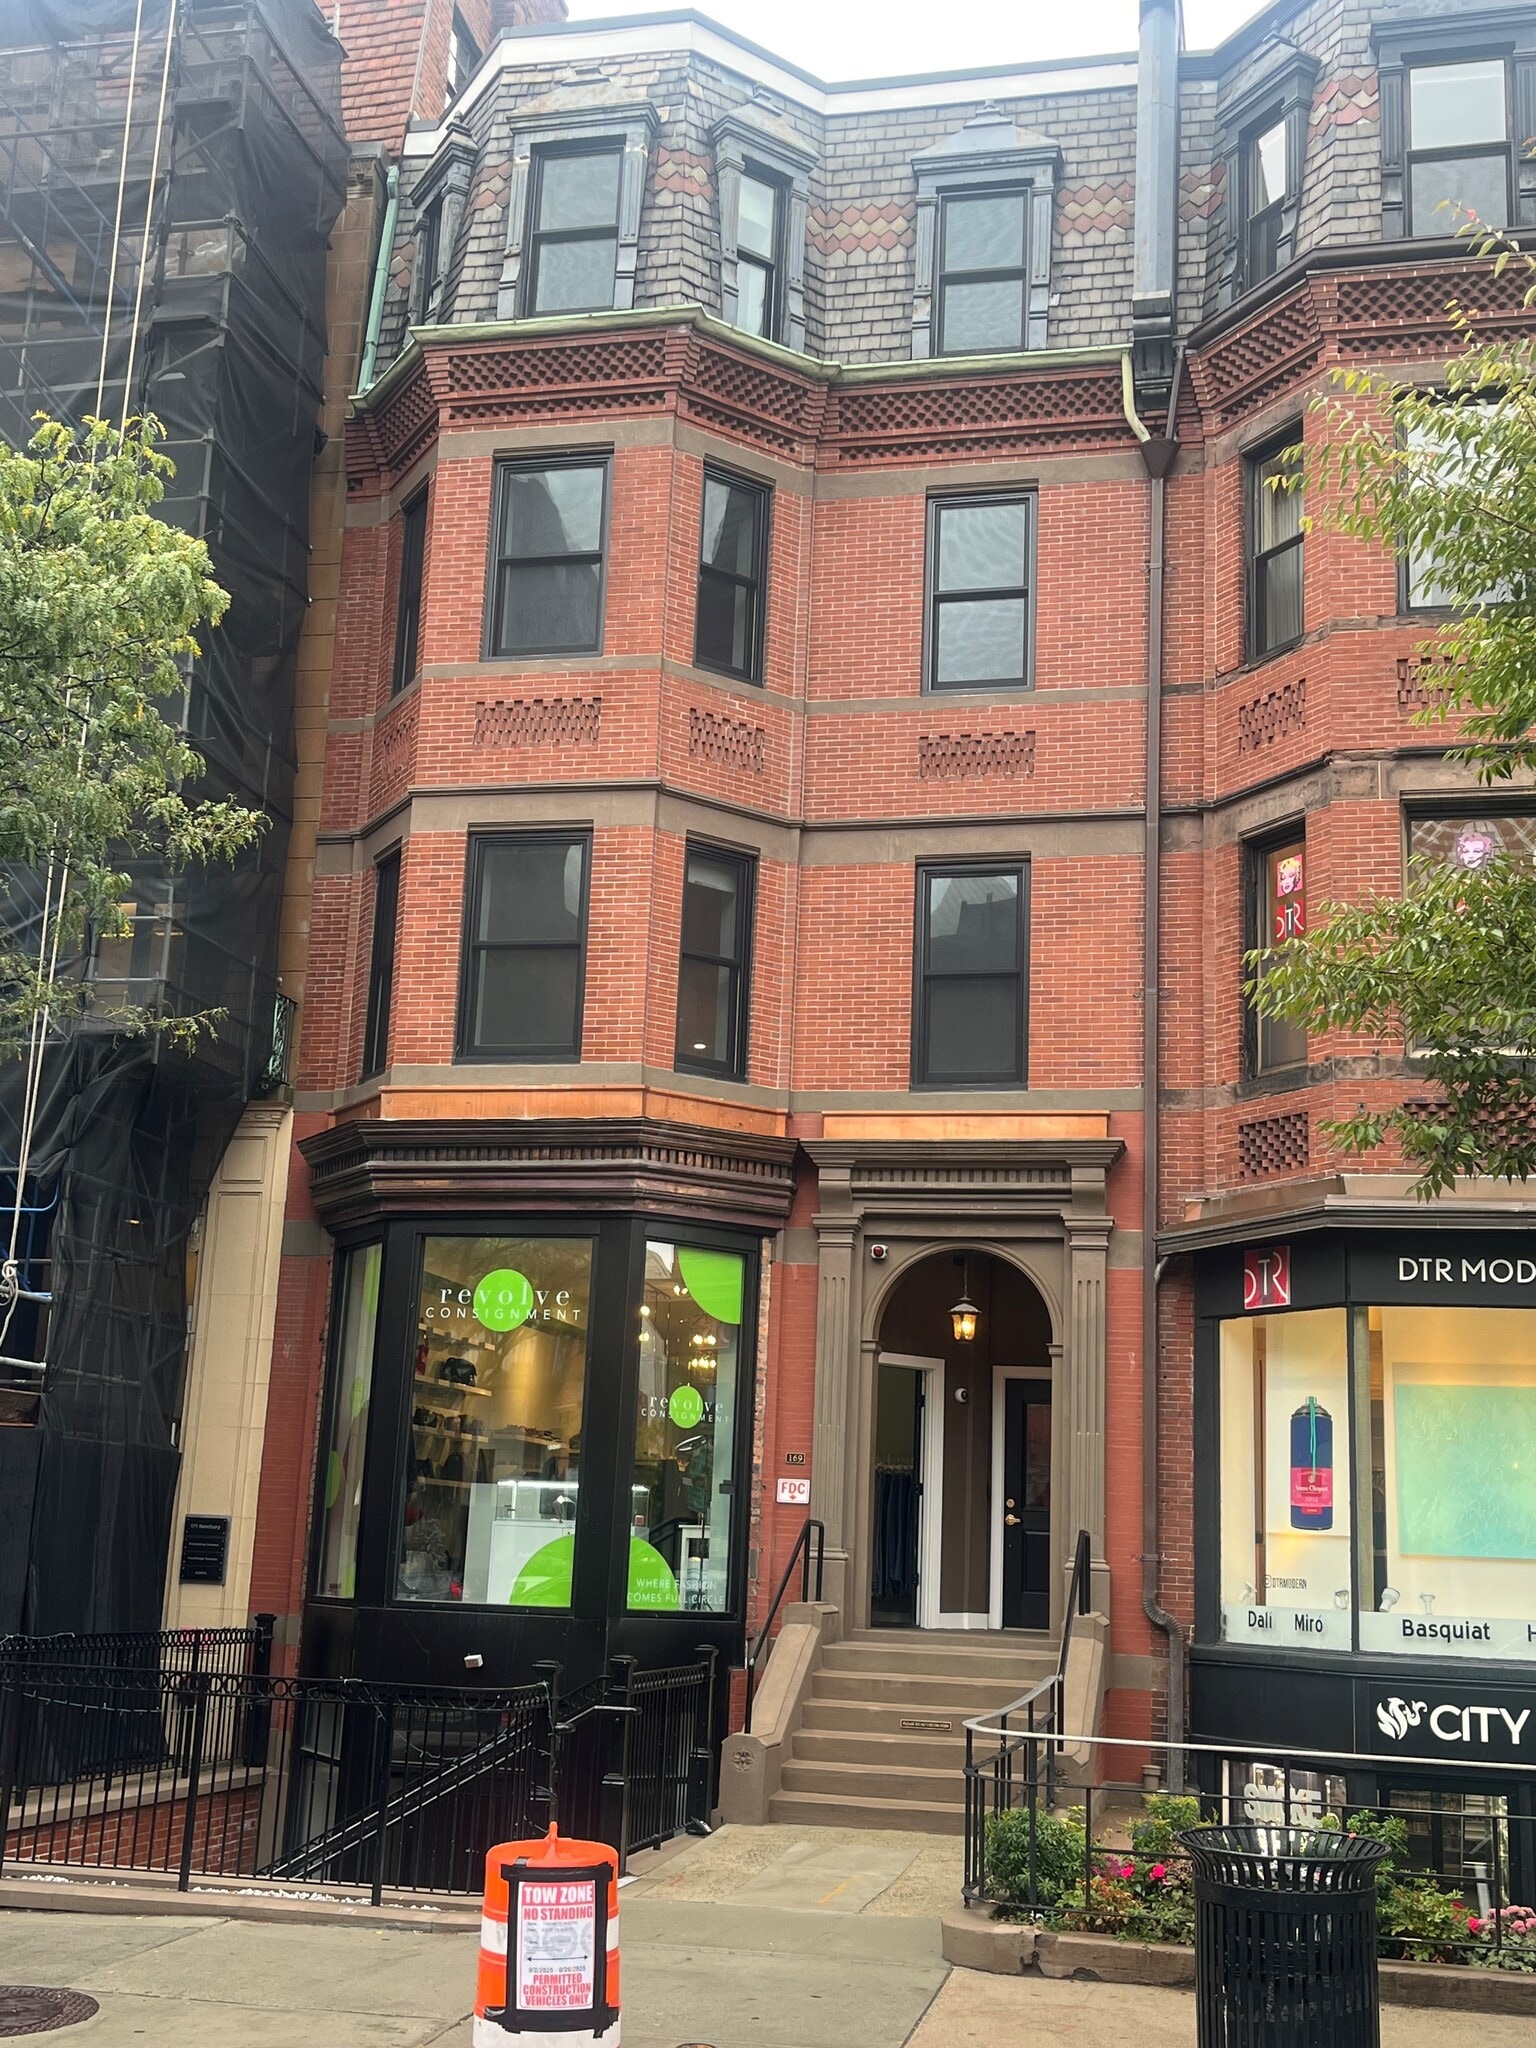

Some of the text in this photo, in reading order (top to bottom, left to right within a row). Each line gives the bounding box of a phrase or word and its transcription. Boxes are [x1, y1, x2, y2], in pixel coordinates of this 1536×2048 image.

[1398, 1257, 1536, 1285] DTR MOD
[440, 1282, 570, 1307] revolve
[425, 1306, 581, 1321] CONSIGNMENT
[649, 1395, 724, 1413] revolve
[641, 1408, 729, 1424] CONSIGNMENT
[788, 1454, 803, 1464] 169
[781, 1482, 806, 1495] FDC
[636, 1578, 717, 1590] WHERE FASHION
[627, 1592, 725, 1605] COMES FULL CIRCLE
[1248, 1610, 1323, 1633] Dalí Miró
[1402, 1618, 1491, 1643] Basquiat
[1429, 1704, 1531, 1745] CITY
[524, 1885, 593, 1904] TOW ZONE
[524, 1905, 593, 1921] NO STANDING
[533, 1973, 582, 1985] PERMITTED
[523, 1983, 591, 1996] CONSTRUCTION
[525, 1994, 589, 2006] VEHICLES ONLY
